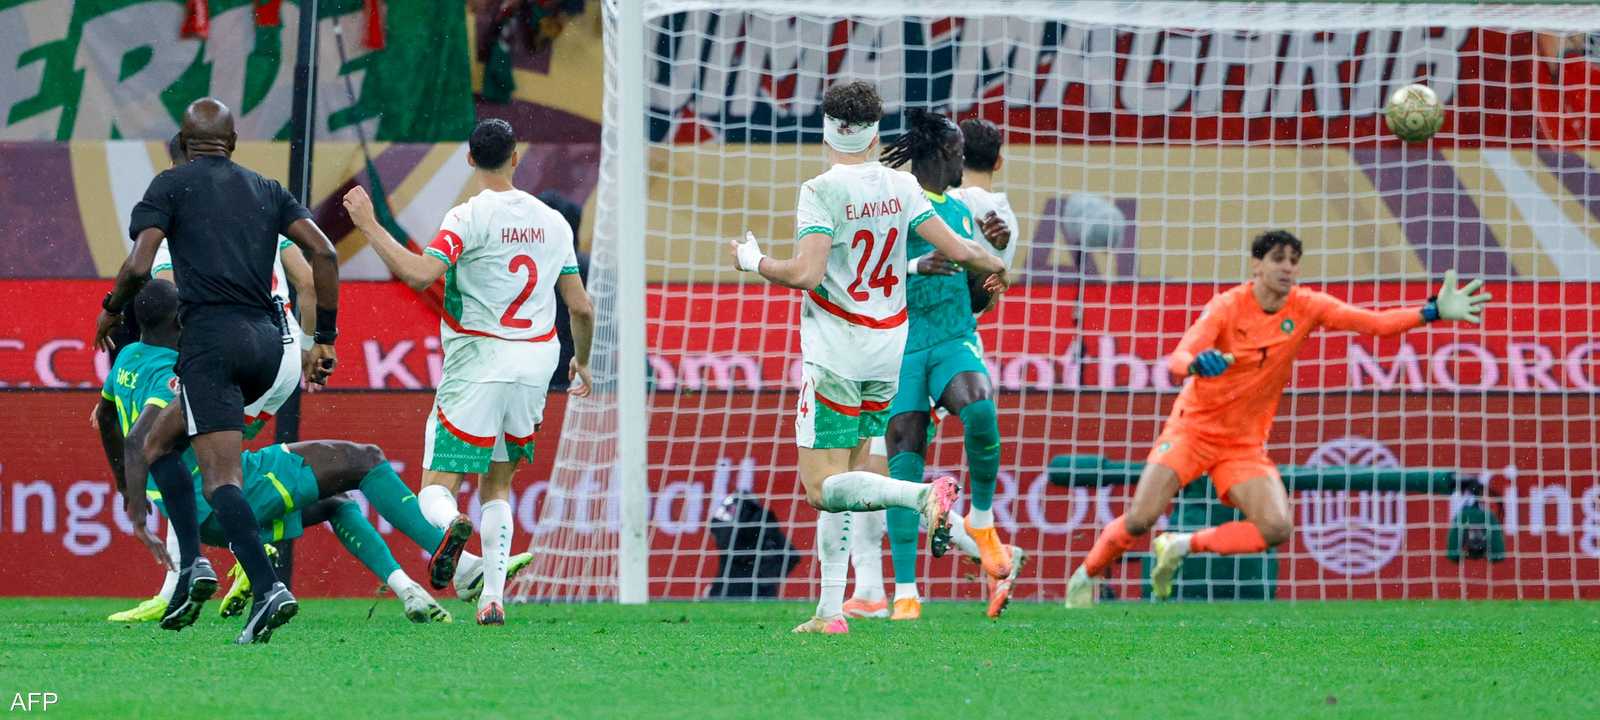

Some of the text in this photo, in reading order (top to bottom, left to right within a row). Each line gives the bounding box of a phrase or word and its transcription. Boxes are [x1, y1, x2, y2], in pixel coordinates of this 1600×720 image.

[846, 204, 860, 220] EL
[501, 227, 545, 244] HAKIMI
[847, 227, 899, 302] 24
[500, 254, 538, 328] 2
